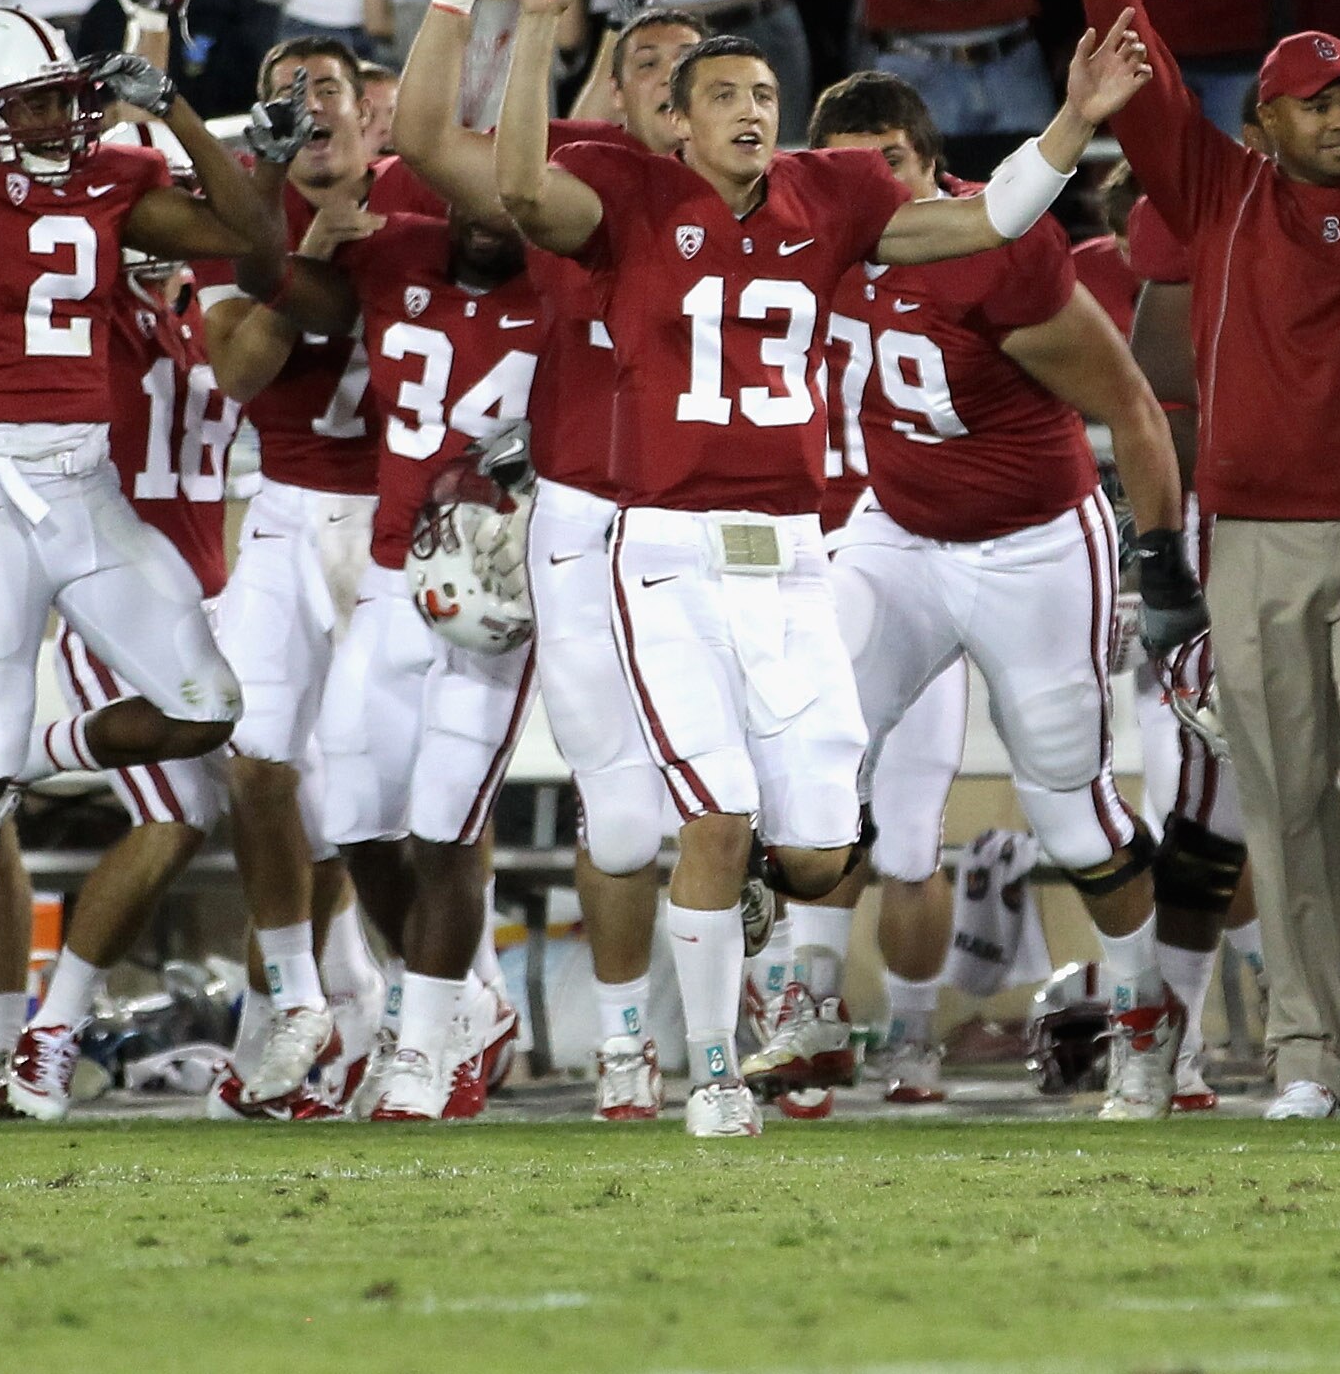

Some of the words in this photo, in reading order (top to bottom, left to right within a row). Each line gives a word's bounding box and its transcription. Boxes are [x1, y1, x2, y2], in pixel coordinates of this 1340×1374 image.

[25, 214, 98, 357] 2
[675, 275, 818, 428] 13
[133, 357, 243, 502] 18
[380, 321, 539, 461] 34
